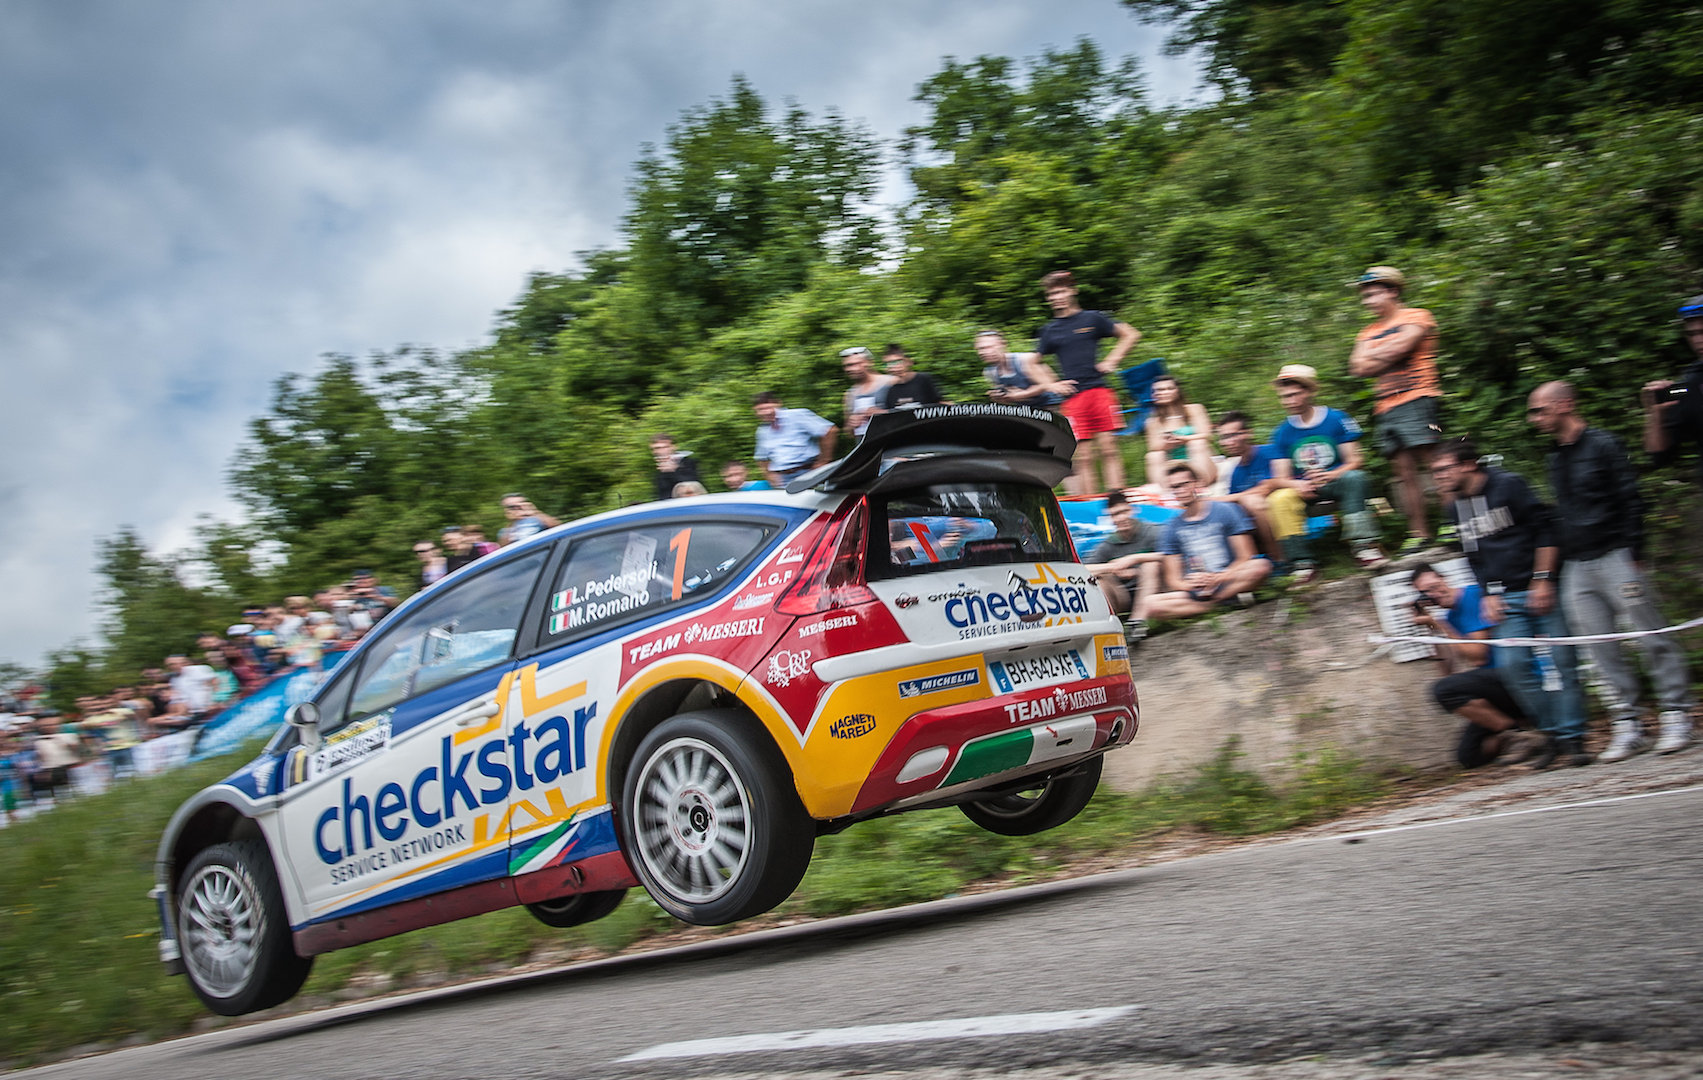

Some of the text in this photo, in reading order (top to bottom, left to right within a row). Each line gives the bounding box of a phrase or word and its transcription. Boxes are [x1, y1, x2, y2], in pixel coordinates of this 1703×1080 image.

[913, 403, 1053, 422] www.magnetimarelli.com
[571, 560, 658, 604] L.Pedersoli
[669, 528, 692, 601] 1
[569, 590, 650, 628] M.Romano
[945, 583, 1089, 628] checkstar
[629, 617, 765, 665] TEAM MESSERI
[798, 615, 858, 638] MESSERI
[959, 619, 1042, 641] SERVICE NETWORK
[921, 671, 976, 690] MICHELIN
[1001, 678, 1007, 689] F
[1004, 653, 1074, 685] BH-642-XF
[1004, 686, 1108, 723] TEAM MESSERI
[315, 700, 598, 866] checkstar
[330, 824, 467, 885] SERVICE NETWORK
